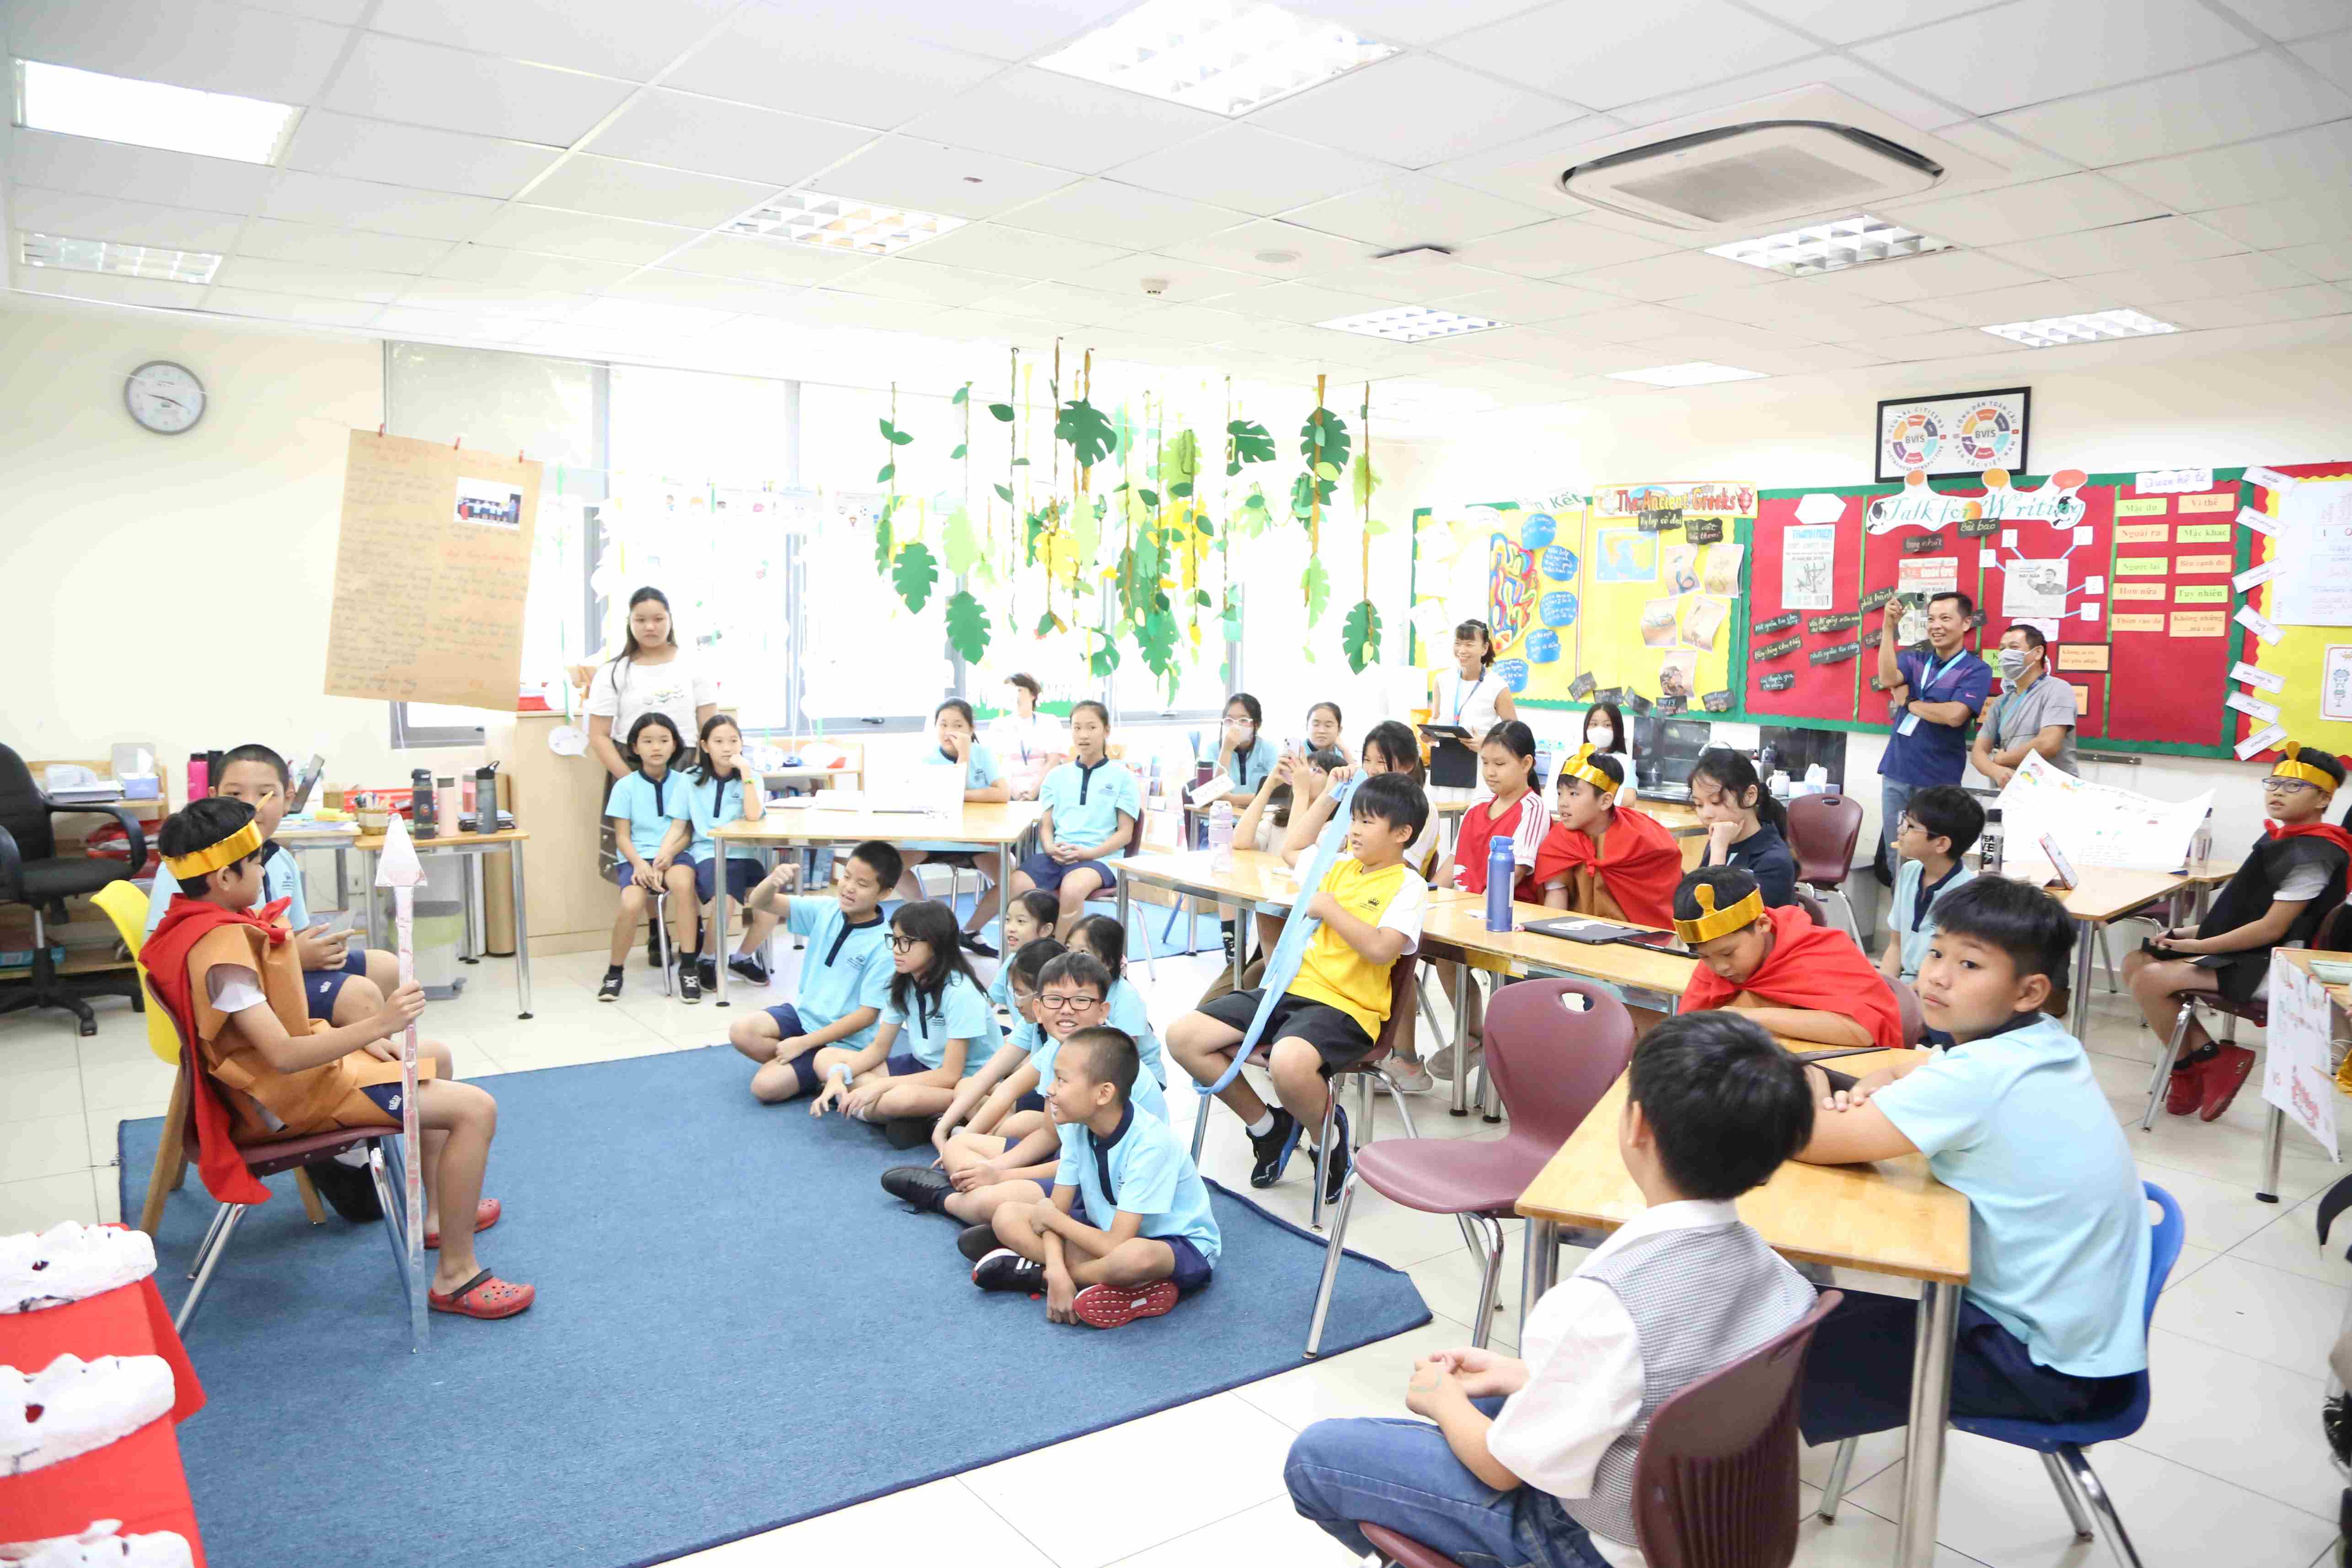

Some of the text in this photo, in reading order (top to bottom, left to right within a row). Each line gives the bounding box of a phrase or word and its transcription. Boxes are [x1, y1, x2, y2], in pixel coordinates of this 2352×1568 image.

[1905, 434, 1925, 444] BVIS
[1975, 429, 1996, 439] BVIS
[1617, 487, 1736, 513] The Ancient Greeks
[1884, 497, 1935, 520] Talk
[1933, 498, 1973, 530] for
